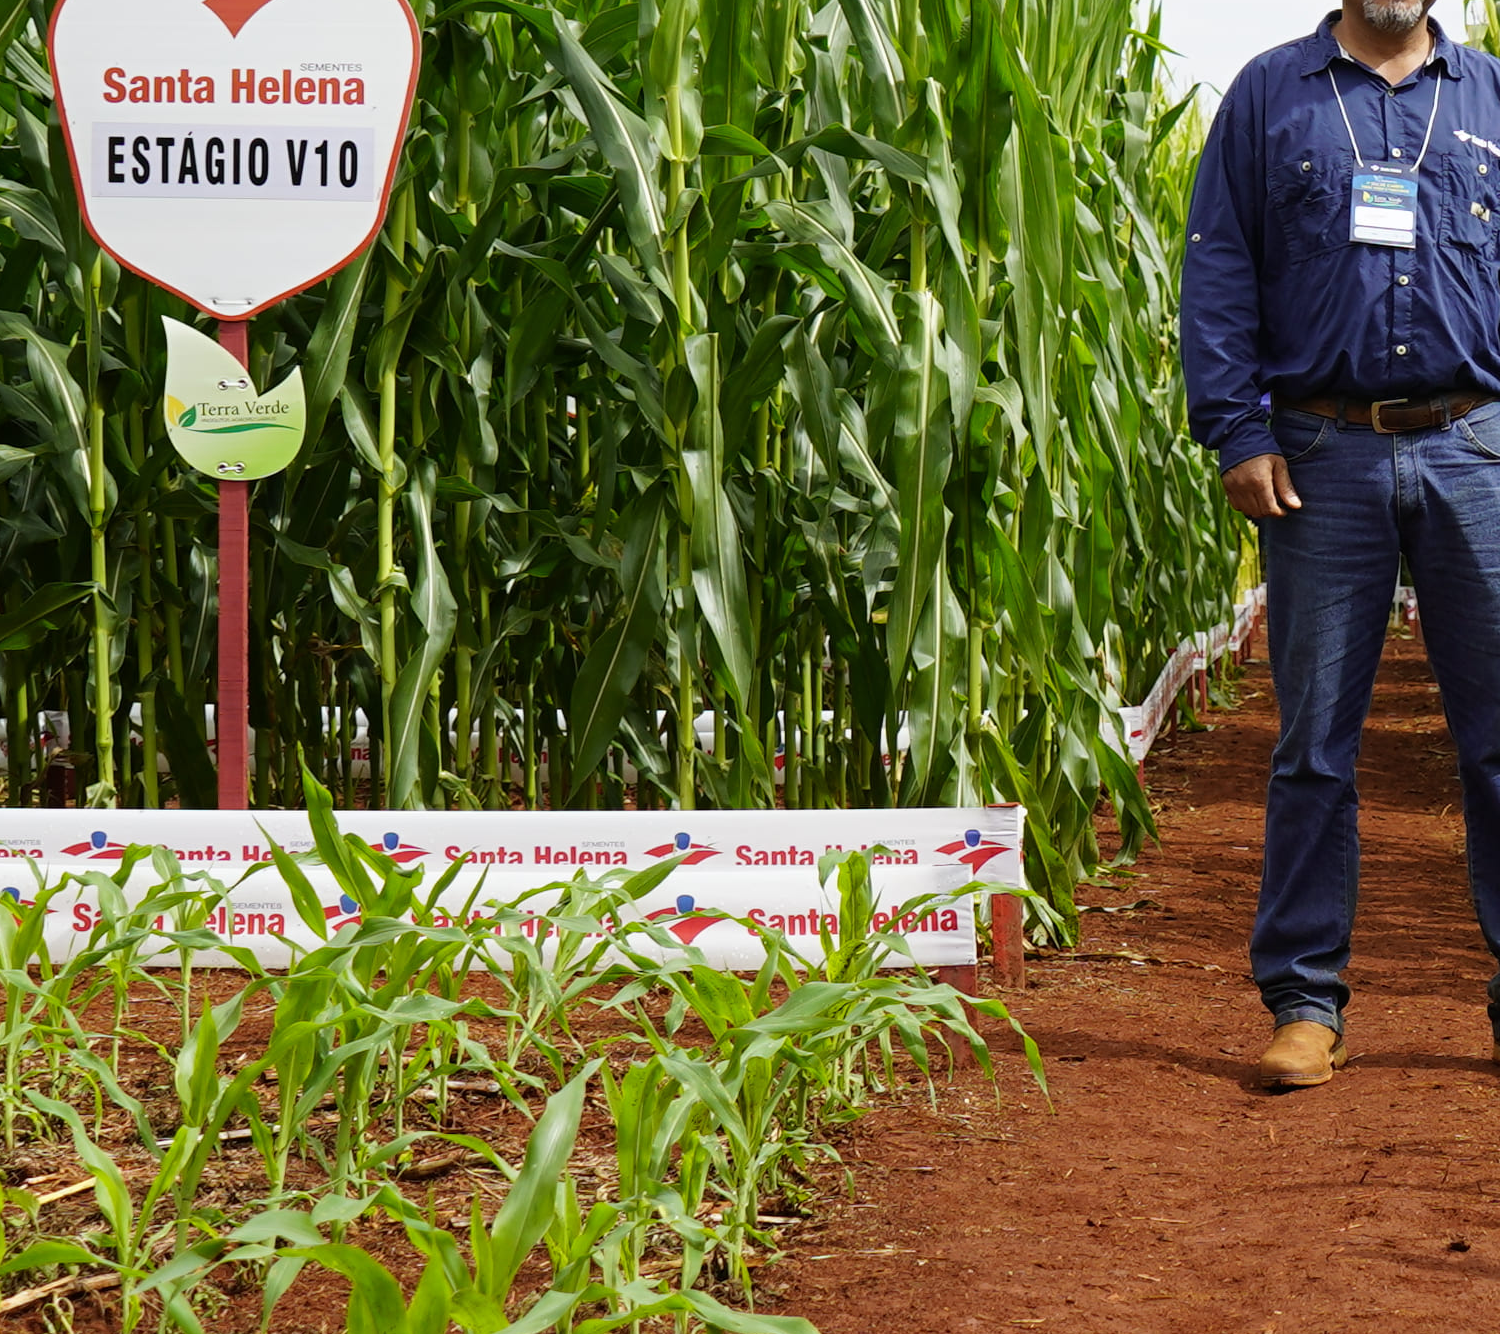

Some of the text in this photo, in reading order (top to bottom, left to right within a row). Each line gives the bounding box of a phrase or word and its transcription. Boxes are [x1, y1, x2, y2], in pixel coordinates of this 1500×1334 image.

[300, 63, 362, 72] SEMENTES
[103, 67, 365, 104] Santa Helena
[108, 131, 358, 188] ESTÁGIO V10
[198, 400, 289, 416] Terra Verde
[736, 845, 814, 865] Santa
[204, 907, 284, 935] elena
[866, 906, 959, 933] elena
